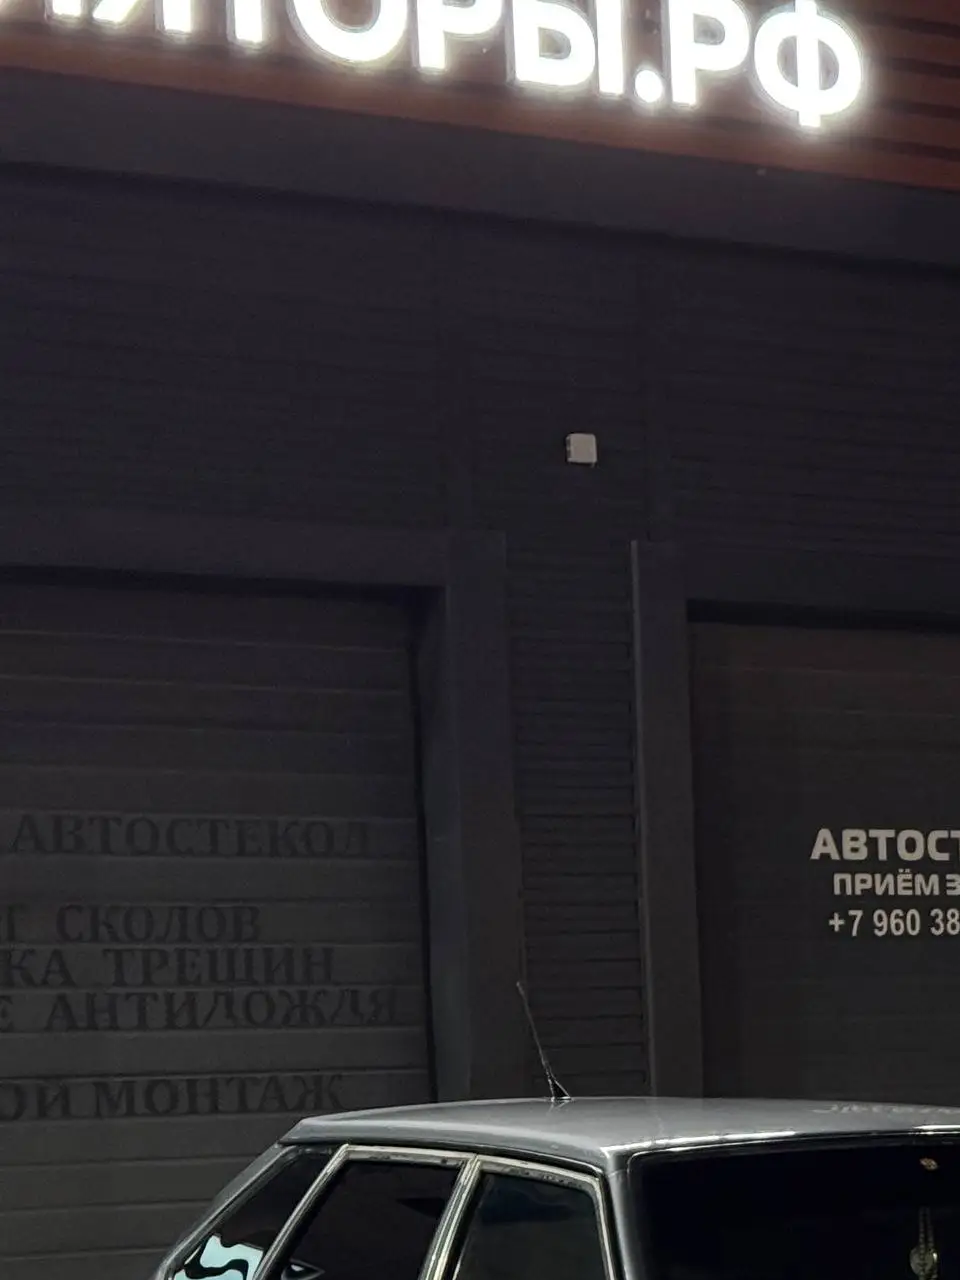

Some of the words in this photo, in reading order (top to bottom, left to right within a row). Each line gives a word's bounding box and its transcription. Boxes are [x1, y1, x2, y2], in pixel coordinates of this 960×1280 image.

[12, 814, 370, 857] АВТОСТЕКОЛ
[833, 868, 940, 895] ПРИЁМ
[55, 904, 262, 943] СКОЛОВ
[828, 909, 863, 936] +7
[873, 908, 920, 936] 960
[103, 947, 335, 987] ТРЕЩИН
[45, 989, 398, 1031] АНТИДОЖДЯ
[94, 1075, 345, 1119] МОНТАЖ
